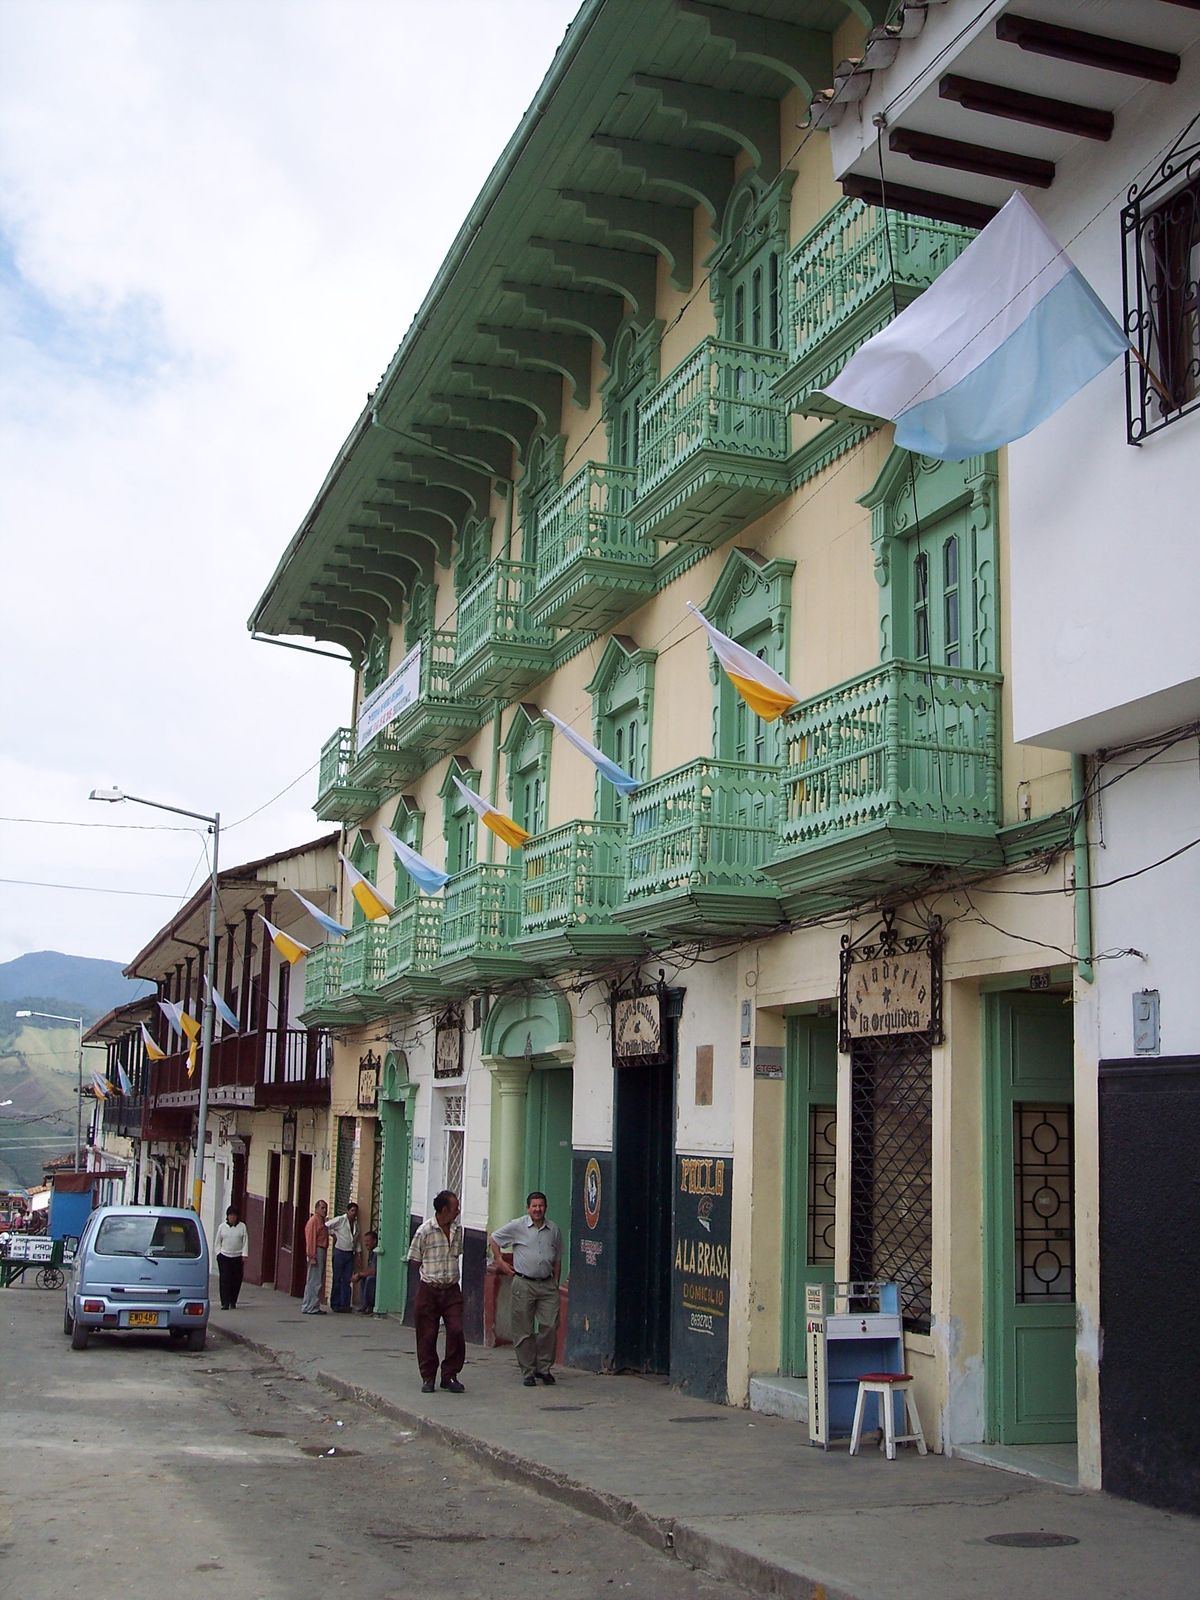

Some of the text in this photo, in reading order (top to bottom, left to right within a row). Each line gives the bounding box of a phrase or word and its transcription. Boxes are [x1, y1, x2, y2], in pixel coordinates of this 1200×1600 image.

[682, 1239, 696, 1275] LA
[697, 1241, 729, 1281] BRASA
[683, 1282, 724, 1306] DOMICILIO
